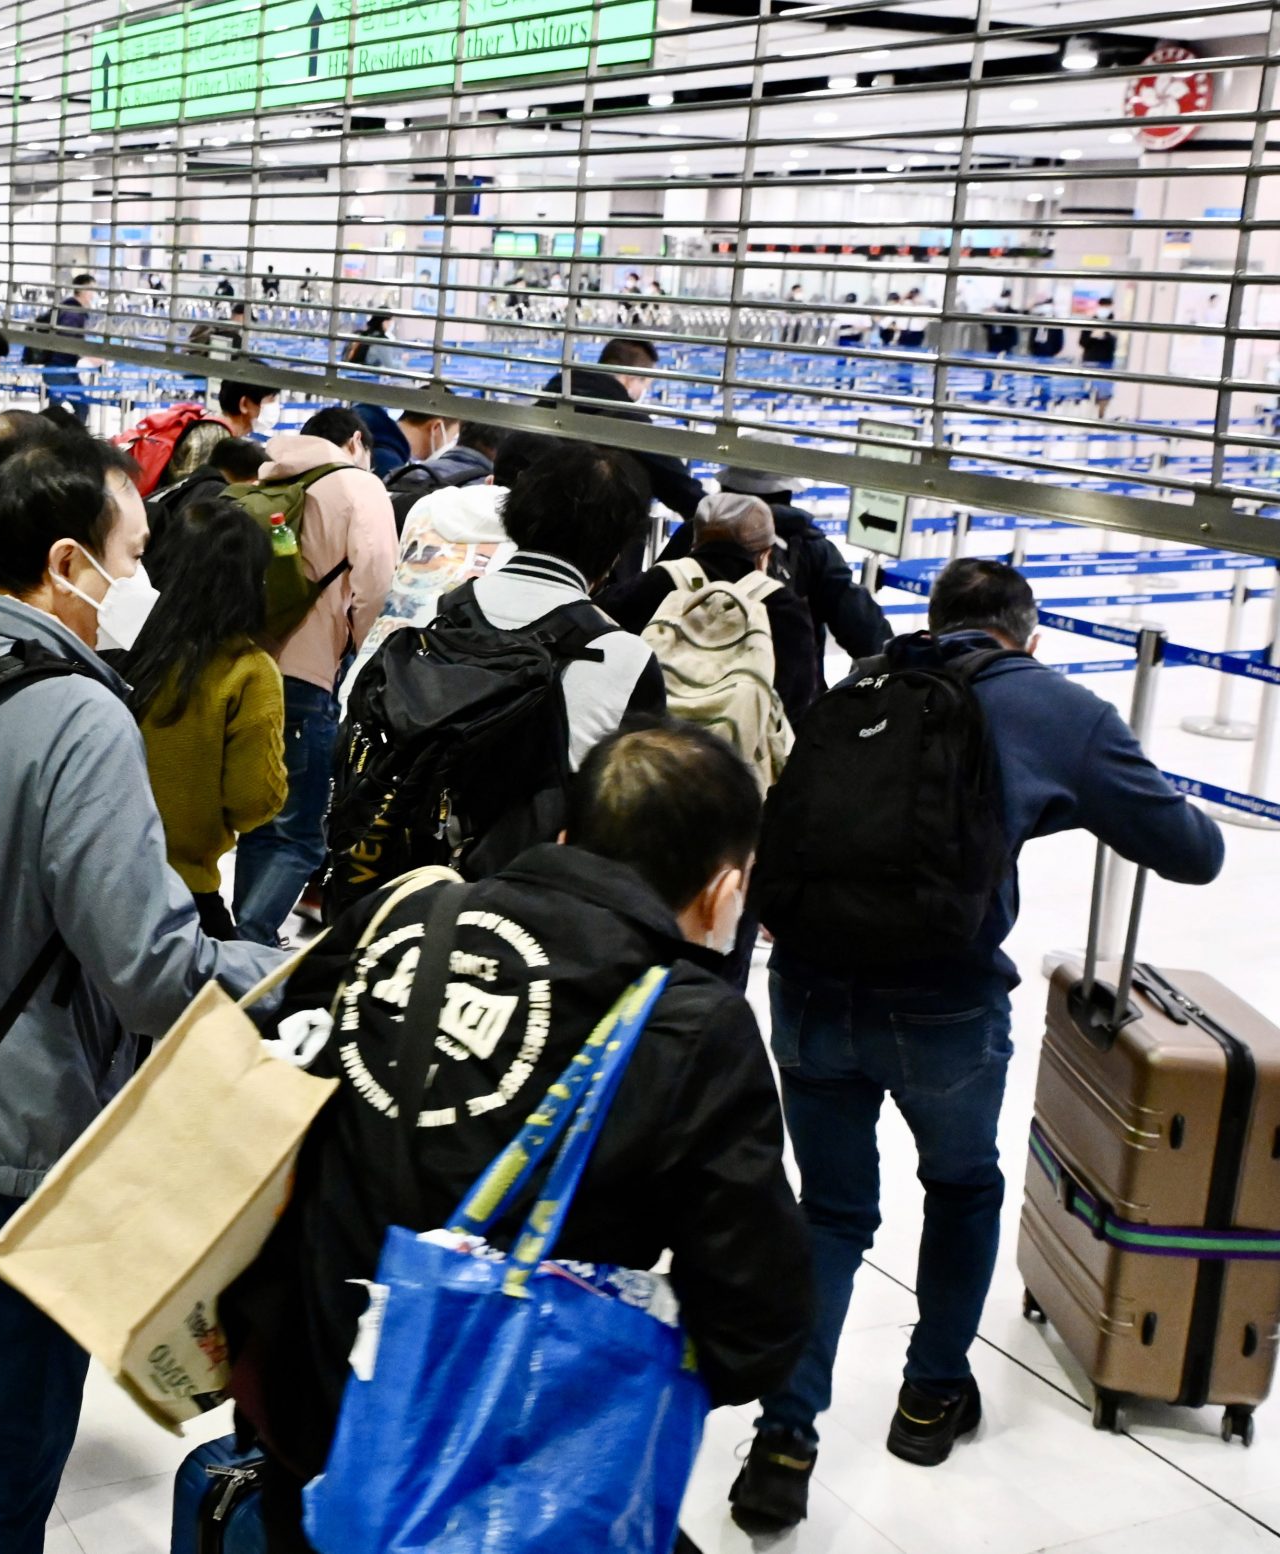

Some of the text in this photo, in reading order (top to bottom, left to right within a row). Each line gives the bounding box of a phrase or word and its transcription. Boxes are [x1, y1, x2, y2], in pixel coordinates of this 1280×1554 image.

[328, 53, 349, 77] HK
[359, 42, 433, 73] Residents
[451, 28, 504, 60] Other
[512, 17, 589, 51] Visitors
